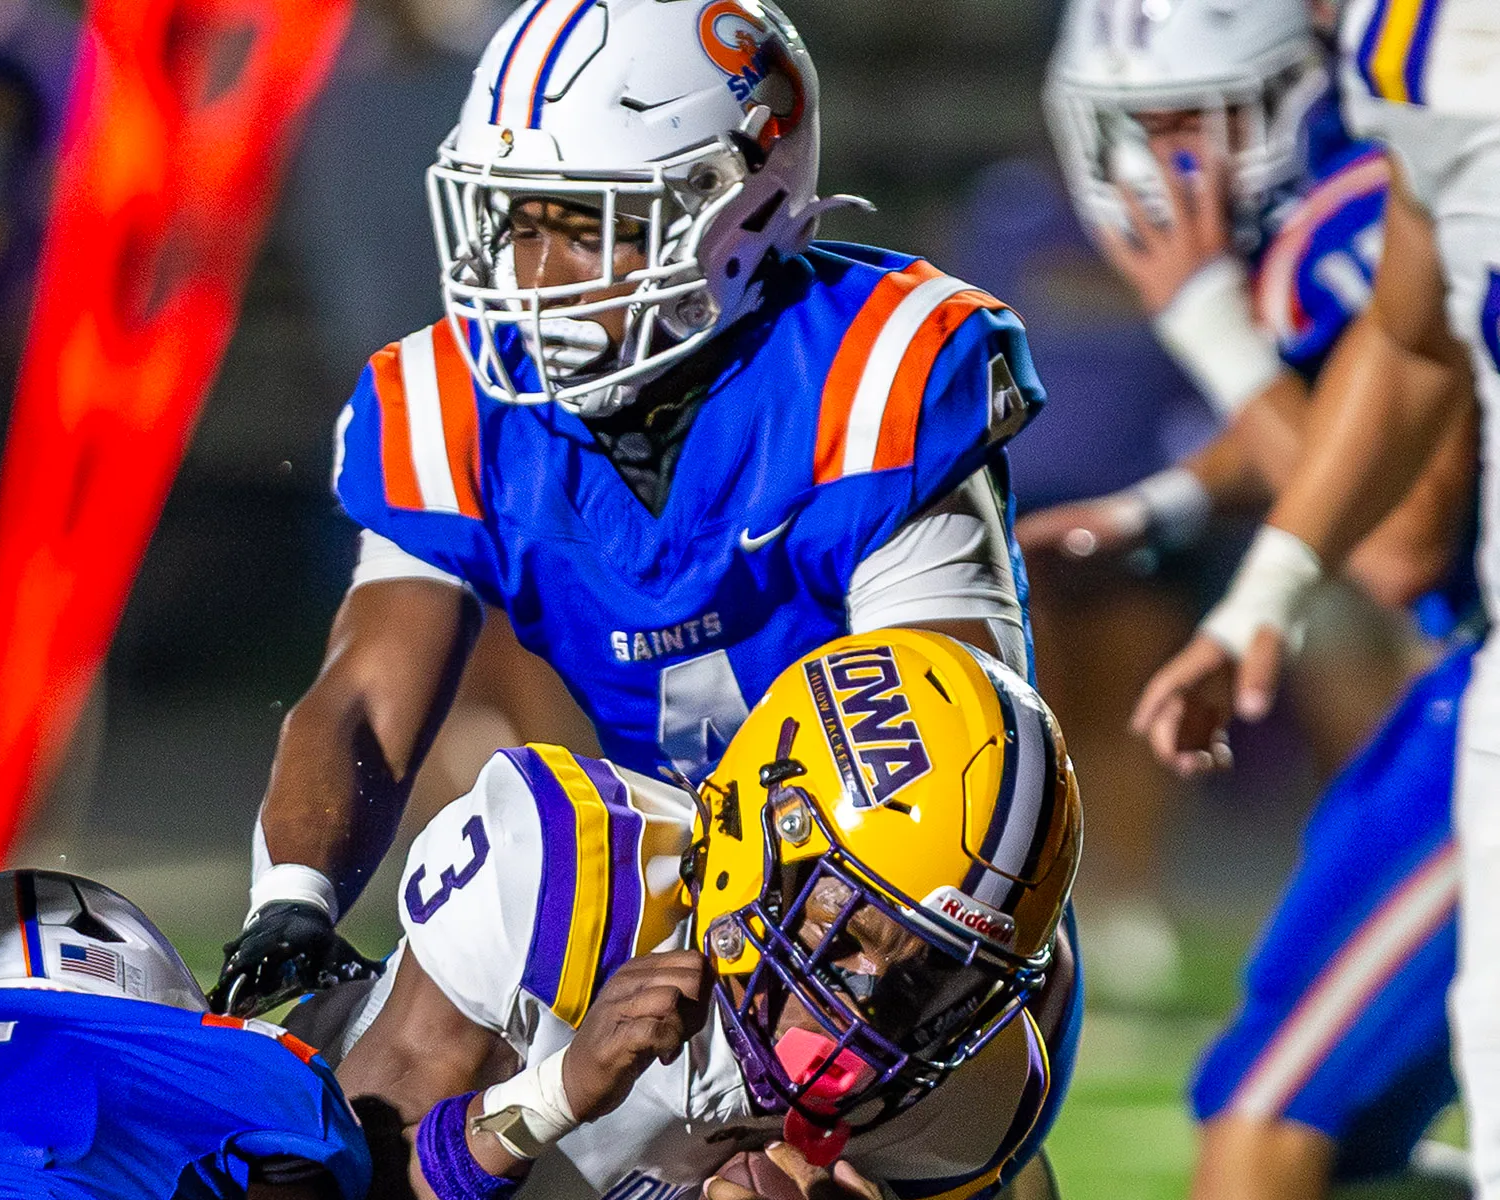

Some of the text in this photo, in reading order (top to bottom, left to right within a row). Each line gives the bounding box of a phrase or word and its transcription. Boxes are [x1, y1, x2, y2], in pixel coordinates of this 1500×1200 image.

[610, 611, 722, 662] SAINTS
[826, 645, 932, 804] IOWA
[404, 814, 491, 925] 3
